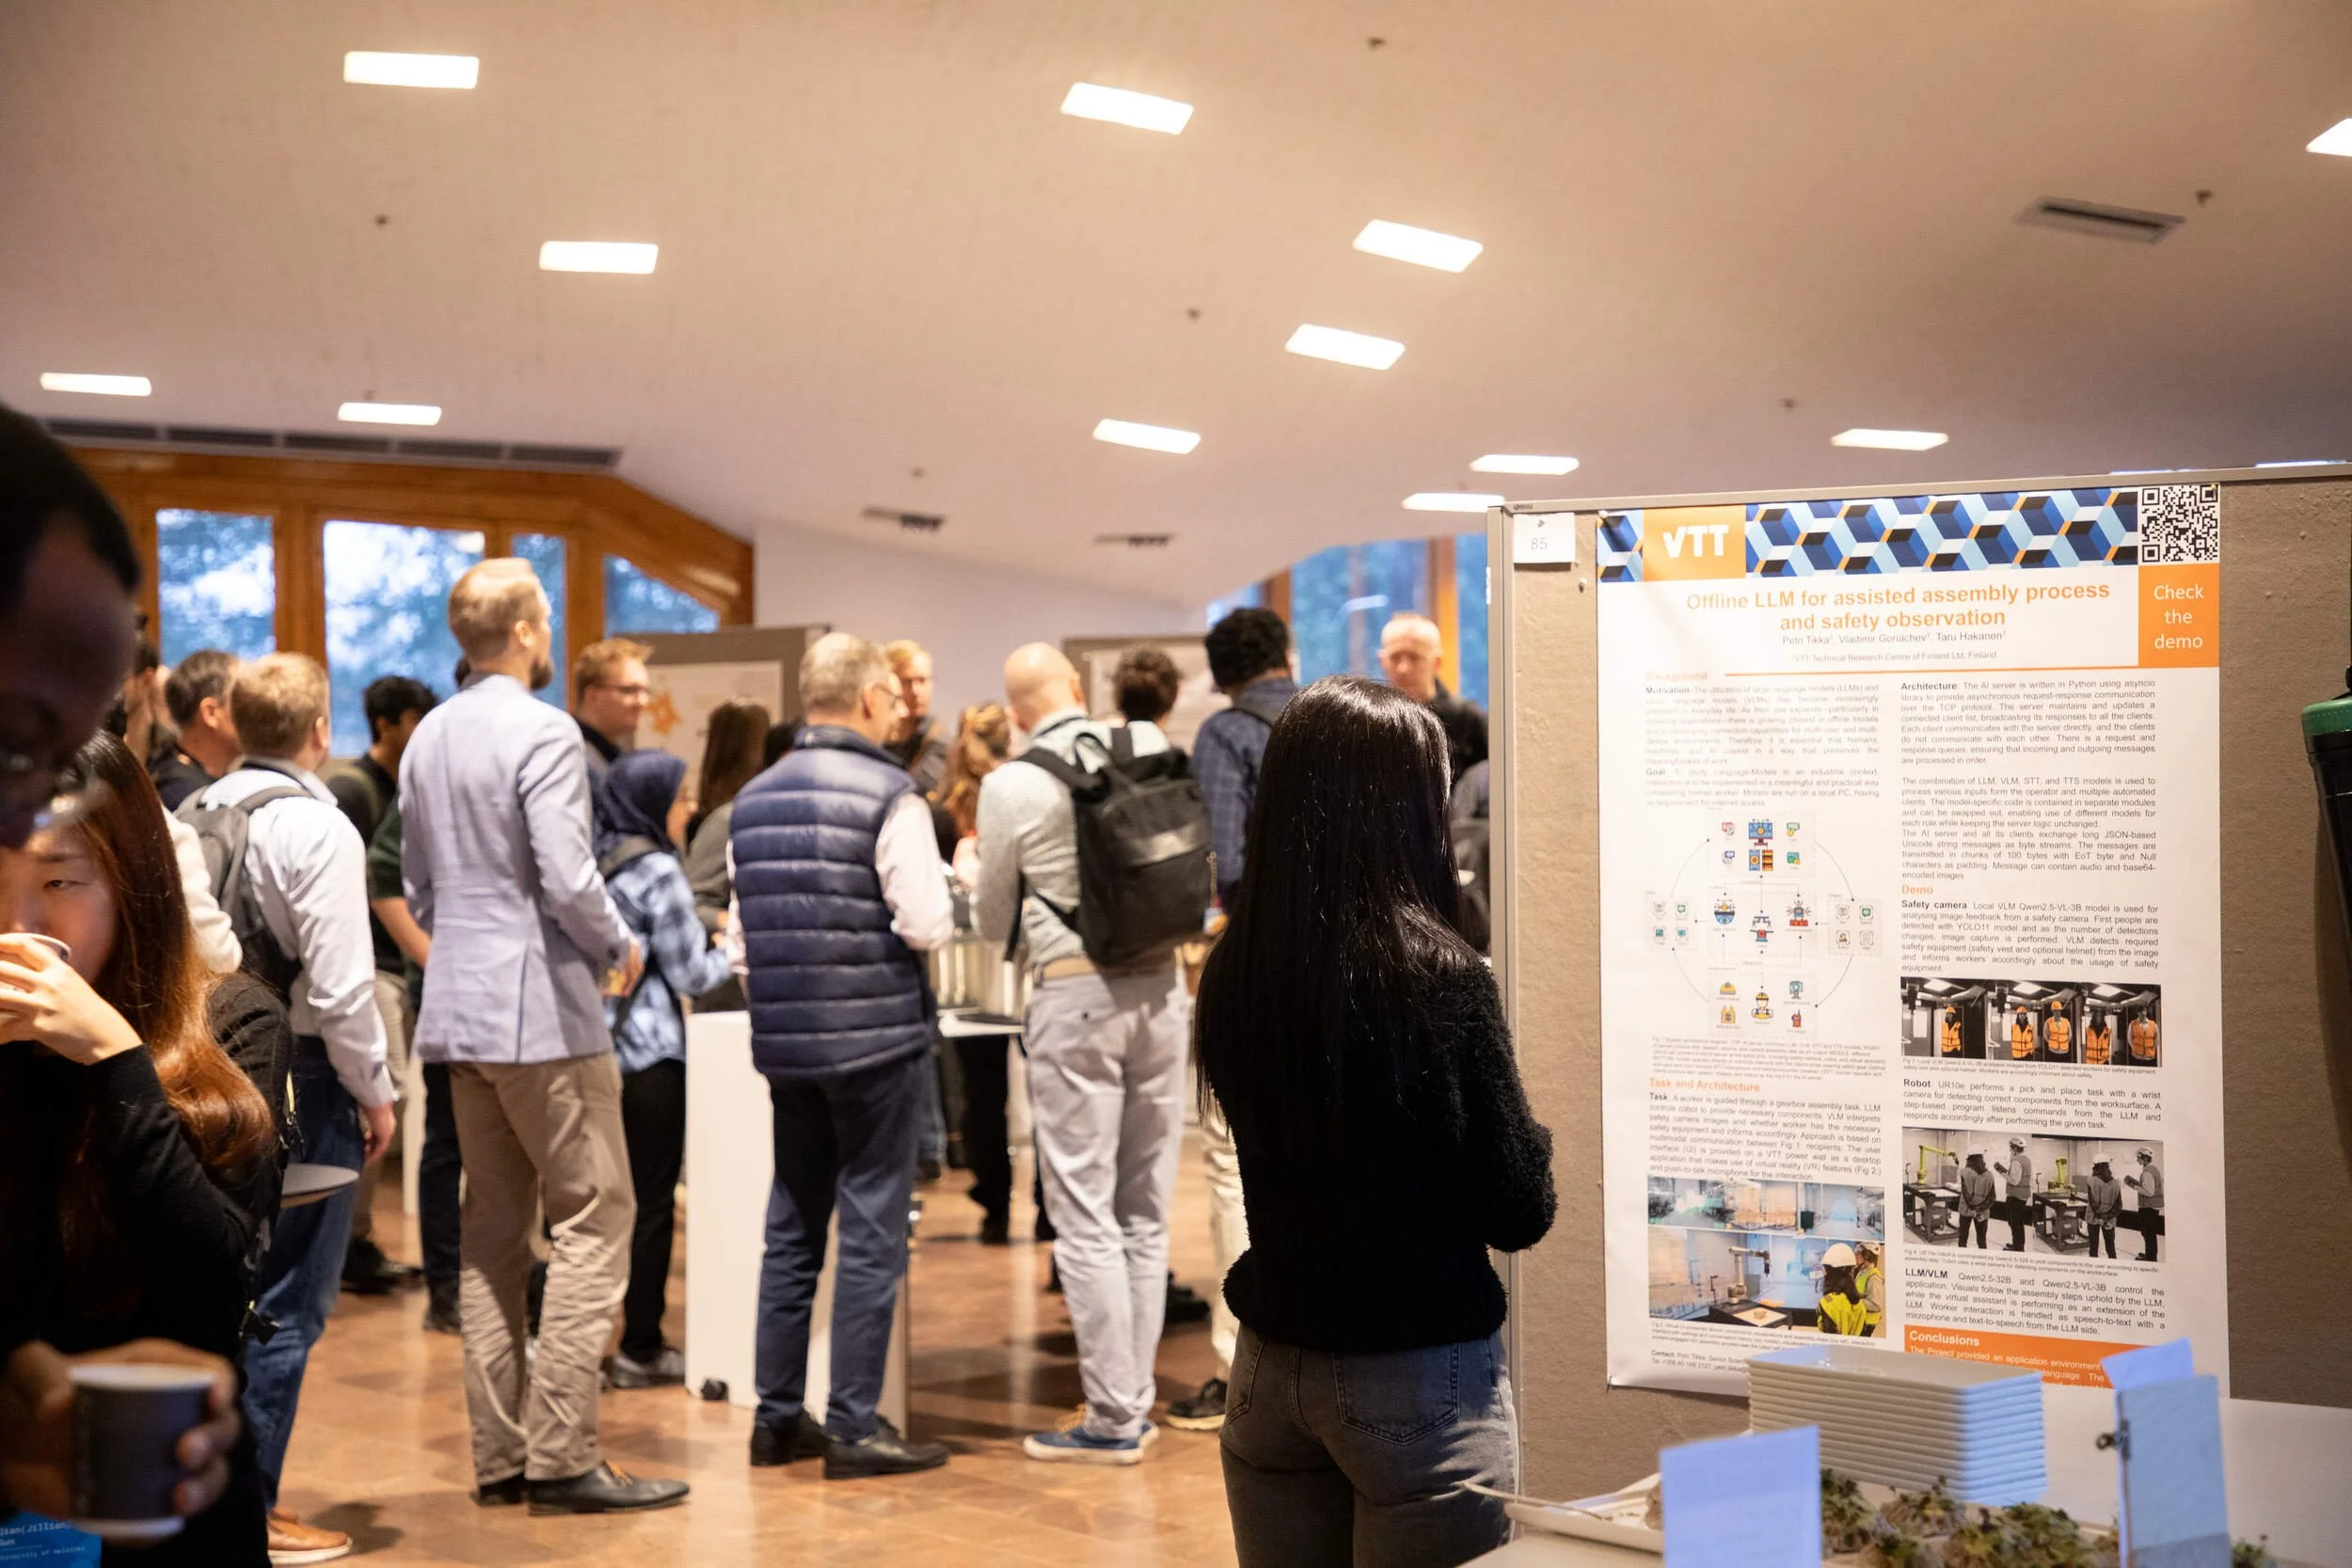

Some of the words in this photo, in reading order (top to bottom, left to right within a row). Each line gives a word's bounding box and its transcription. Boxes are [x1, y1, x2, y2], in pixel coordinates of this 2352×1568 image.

[1530, 537, 1548, 550] 85
[1664, 525, 1728, 557] VTT
[1687, 590, 1748, 609] Offline
[1754, 589, 1794, 607] LLM
[1802, 588, 1827, 606] for
[1835, 586, 1915, 605] assisted
[1922, 583, 2018, 608] assembly
[2026, 585, 2109, 605] process
[2154, 585, 2202, 599] Check
[1780, 612, 1816, 630] and
[1821, 610, 1880, 634] safety
[1886, 608, 2006, 627] observation
[2166, 611, 2191, 623] the
[1938, 632, 1957, 641] Taru
[2155, 635, 2202, 648] demo
[2068, 680, 2097, 689] Python
[2100, 679, 2122, 689] using
[2124, 679, 2155, 689] asyncio
[1900, 693, 1924, 704] library
[1936, 692, 1964, 703] provide
[1966, 691, 2021, 702] asynchronous
[2023, 690, 2092, 701] request-response
[1901, 884, 1933, 895] Demo
[1901, 900, 1930, 910] Safety
[1973, 901, 1994, 910] Local
[1994, 923, 2018, 931] model
[2071, 925, 2101, 933] number
[2117, 927, 2158, 935] detections
[1649, 1077, 1672, 1087] Task
[1675, 1078, 1695, 1088] and
[1695, 1079, 1761, 1091] Architecture
[1938, 1081, 1965, 1089] UR10e
[1970, 1082, 2005, 1093] performs
[2019, 1085, 2035, 1094] pick
[2060, 1086, 2082, 1097] place
[2087, 1087, 2105, 1096] task
[2141, 1091, 2161, 1100] wrist
[1947, 1092, 1982, 1102] detecting
[1984, 1093, 2011, 1102] correct
[2013, 1095, 2062, 1106] components
[2064, 1097, 2083, 1105] from
[1904, 1101, 1946, 1112] step-based
[1952, 1104, 1985, 1114] program
[1992, 1104, 2016, 1113] listens
[2024, 1106, 2067, 1116] commands
[2074, 1109, 2092, 1117] from
[2100, 1110, 2113, 1118] the
[2120, 1111, 2138, 1119] LLM
[2146, 1113, 2161, 1121] and
[1904, 1110, 1939, 1121] responds
[1940, 1112, 1984, 1124] accordingly
[1986, 1115, 2003, 1123] after
[2006, 1116, 2048, 1127] performing
[2064, 1119, 2086, 1130] given
[1951, 1283, 1979, 1292] Visuals
[1981, 1285, 2004, 1294] follow
[2007, 1287, 2019, 1295] the
[2021, 1288, 2058, 1300] assembly
[2061, 1291, 2083, 1302] steps
[2086, 1293, 2113, 1305] uphold
[2115, 1296, 2125, 1306] by
[2128, 1297, 2141, 1306] the
[2020, 1277, 2035, 1286] and
[2115, 1285, 2143, 1294] control
[2152, 1288, 2165, 1296] the
[1905, 1291, 1925, 1299] while
[1929, 1291, 1942, 1300] the
[1945, 1292, 1968, 1302] virtual
[1972, 1295, 2007, 1305] assistant
[2021, 1299, 2064, 1311] performing
[2096, 1305, 2136, 1316] extension
[2139, 1308, 2148, 1317] of
[2152, 1309, 2166, 1318] the
[1906, 1310, 1951, 1323] microphone
[1952, 1314, 1967, 1323] and
[1969, 1316, 2025, 1330] text-to-speech
[2026, 1321, 2044, 1329] from
[2046, 1323, 2058, 1331] the
[2061, 1323, 2079, 1333] LLM
[1931, 1302, 1958, 1311] Worker
[1963, 1305, 2004, 1315] interaction
[2021, 1309, 2053, 1320] handled
[2074, 1314, 2132, 1328] speech-to-text
[2137, 1320, 2154, 1328] with
[1909, 1330, 1979, 1346] Conclusions
[1910, 1346, 1926, 1354] The
[1927, 1347, 1955, 1359] Project
[1957, 1350, 1991, 1362] provided
[2006, 1354, 2050, 1368] application
[2050, 1358, 2100, 1370] environment
